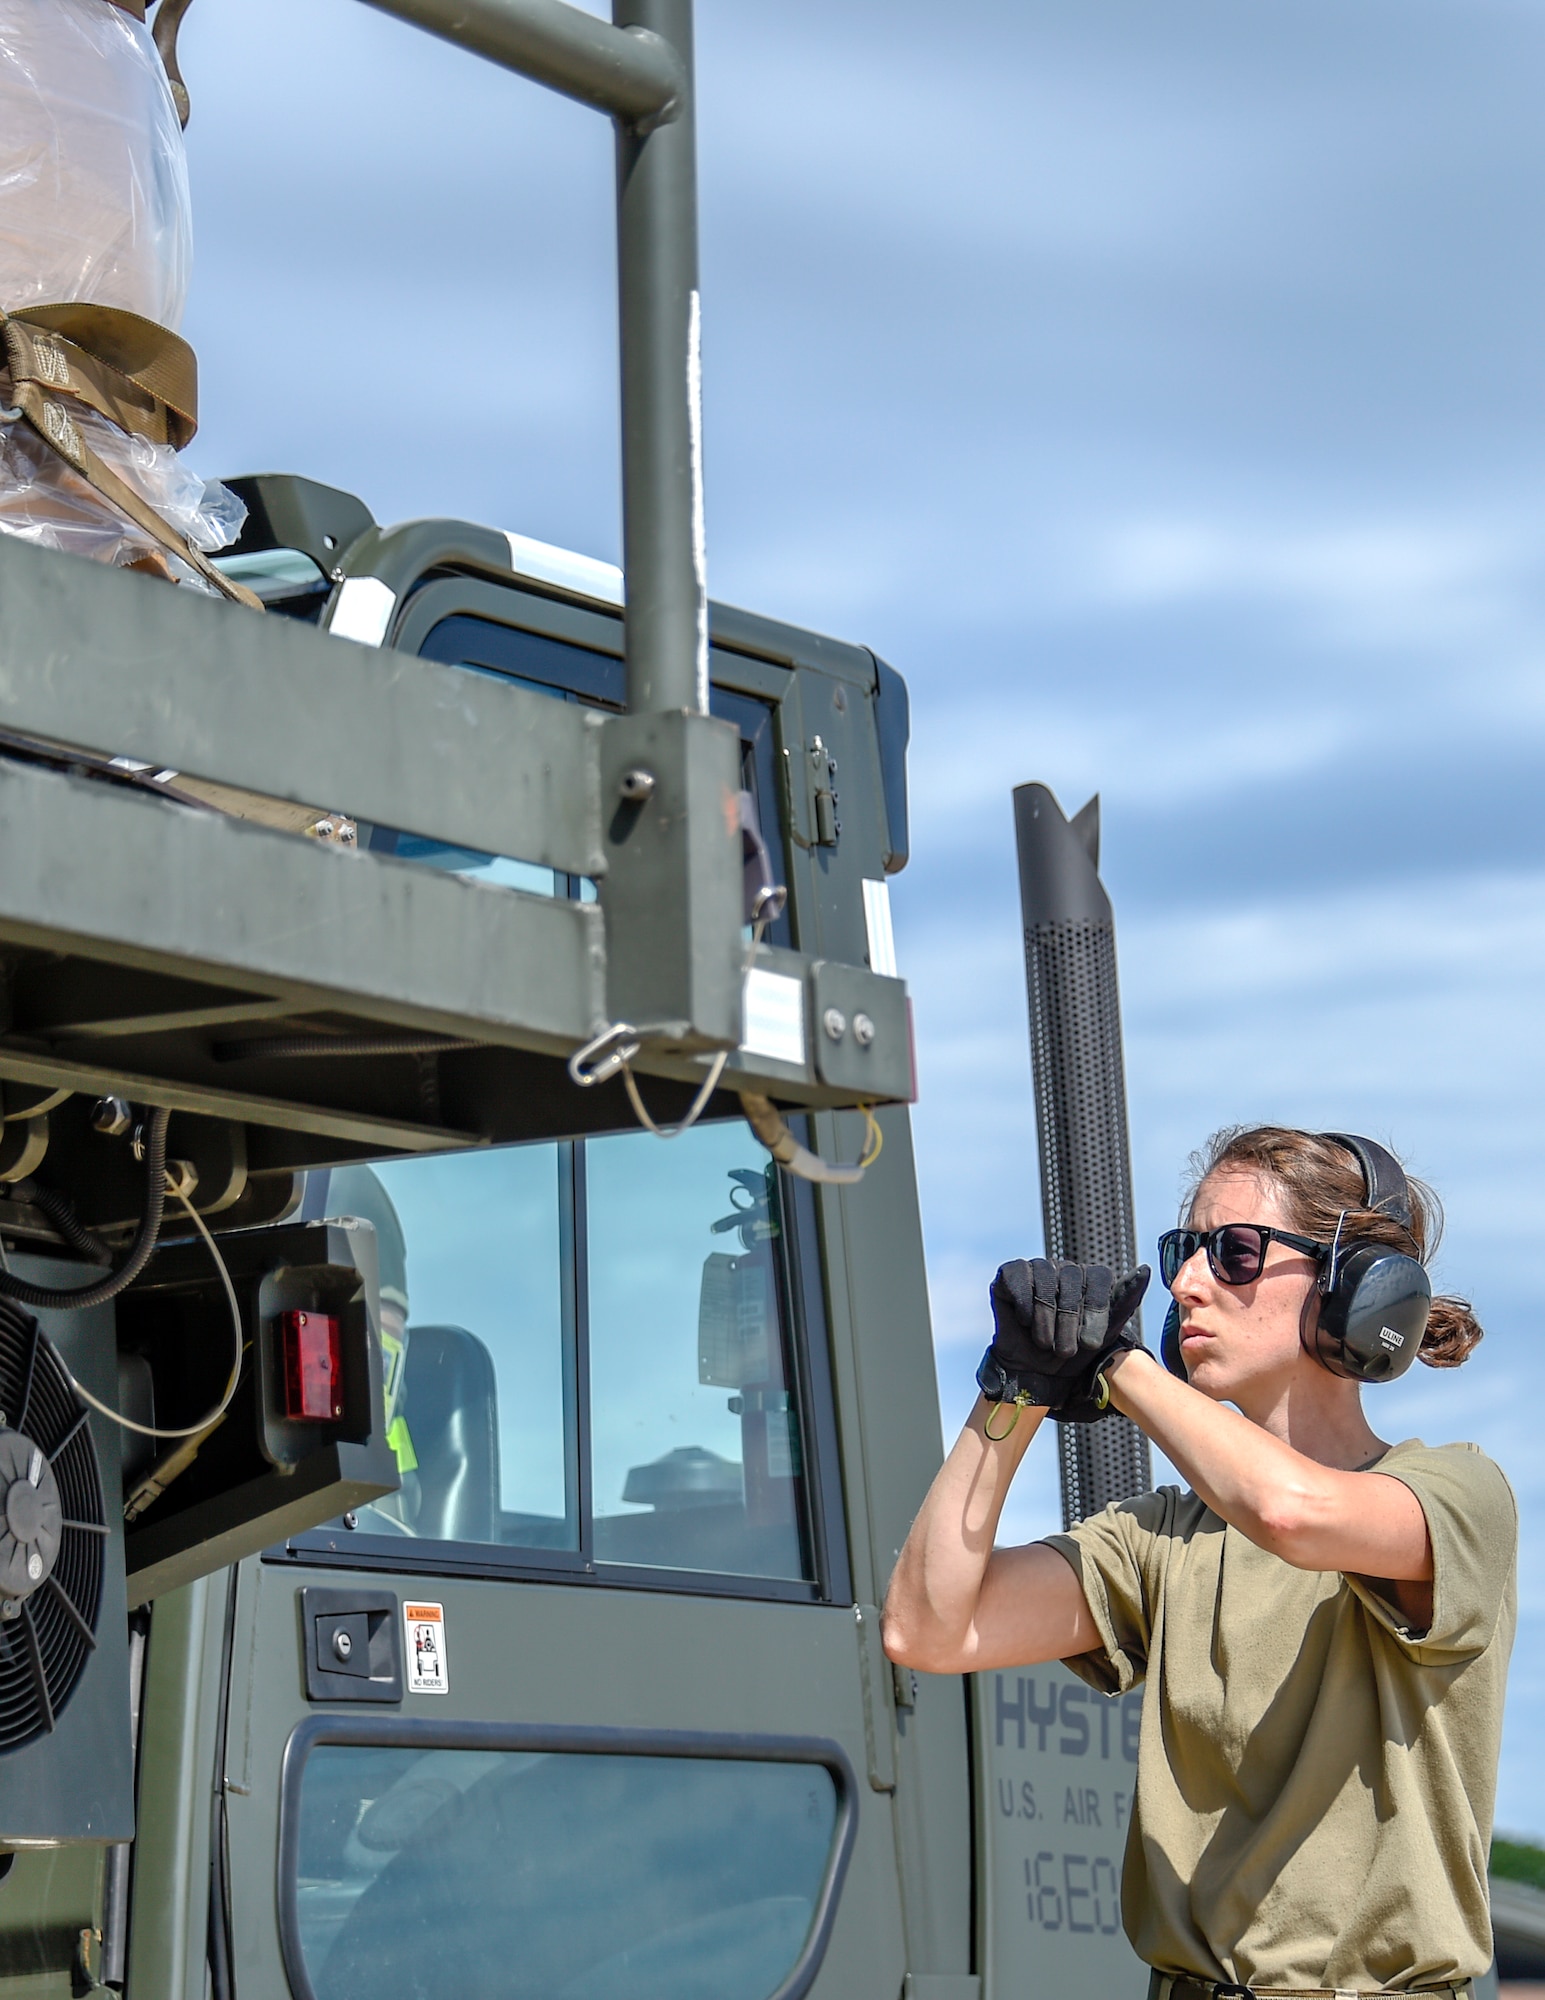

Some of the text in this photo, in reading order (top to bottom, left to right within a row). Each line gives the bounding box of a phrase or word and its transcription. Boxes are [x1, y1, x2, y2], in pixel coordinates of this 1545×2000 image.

[1382, 1328, 1403, 1345] ULINE
[414, 1609, 440, 1619] WARNING
[414, 1678, 422, 1686] NO
[998, 1777, 1135, 1829] U.S. AIR F
[1024, 1851, 1122, 1936] 16E0
